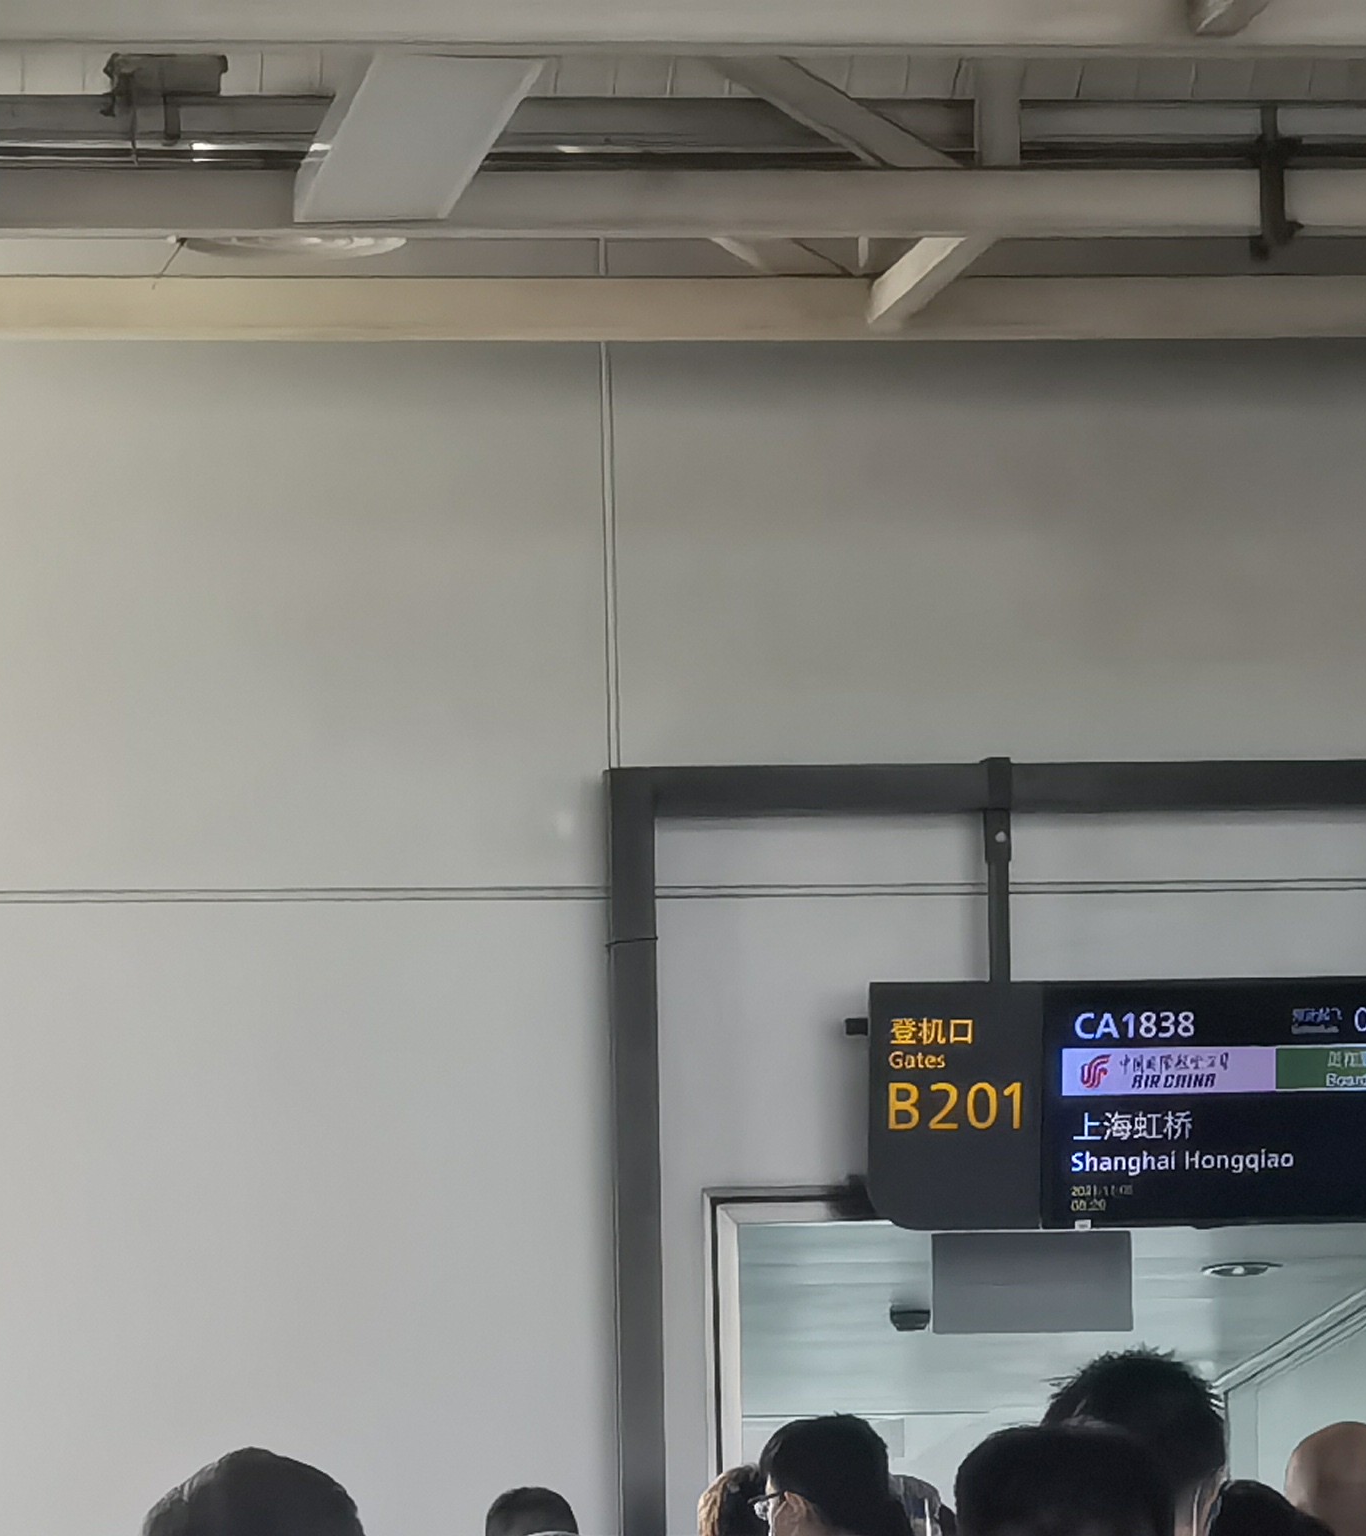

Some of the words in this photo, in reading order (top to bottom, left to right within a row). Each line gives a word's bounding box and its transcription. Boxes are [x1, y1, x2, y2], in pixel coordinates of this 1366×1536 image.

[889, 1017, 974, 1045] 登机口
[1073, 1011, 1195, 1039] CA1838
[888, 1050, 946, 1070] Gates
[1131, 1073, 1161, 1089] AIR
[1163, 1072, 1217, 1089] CHINA
[888, 1081, 1023, 1130] B201
[1072, 1111, 1193, 1141] 上海虹桥
[1070, 1151, 1176, 1176] Shanghai
[1185, 1148, 1295, 1174] Hongqiao
